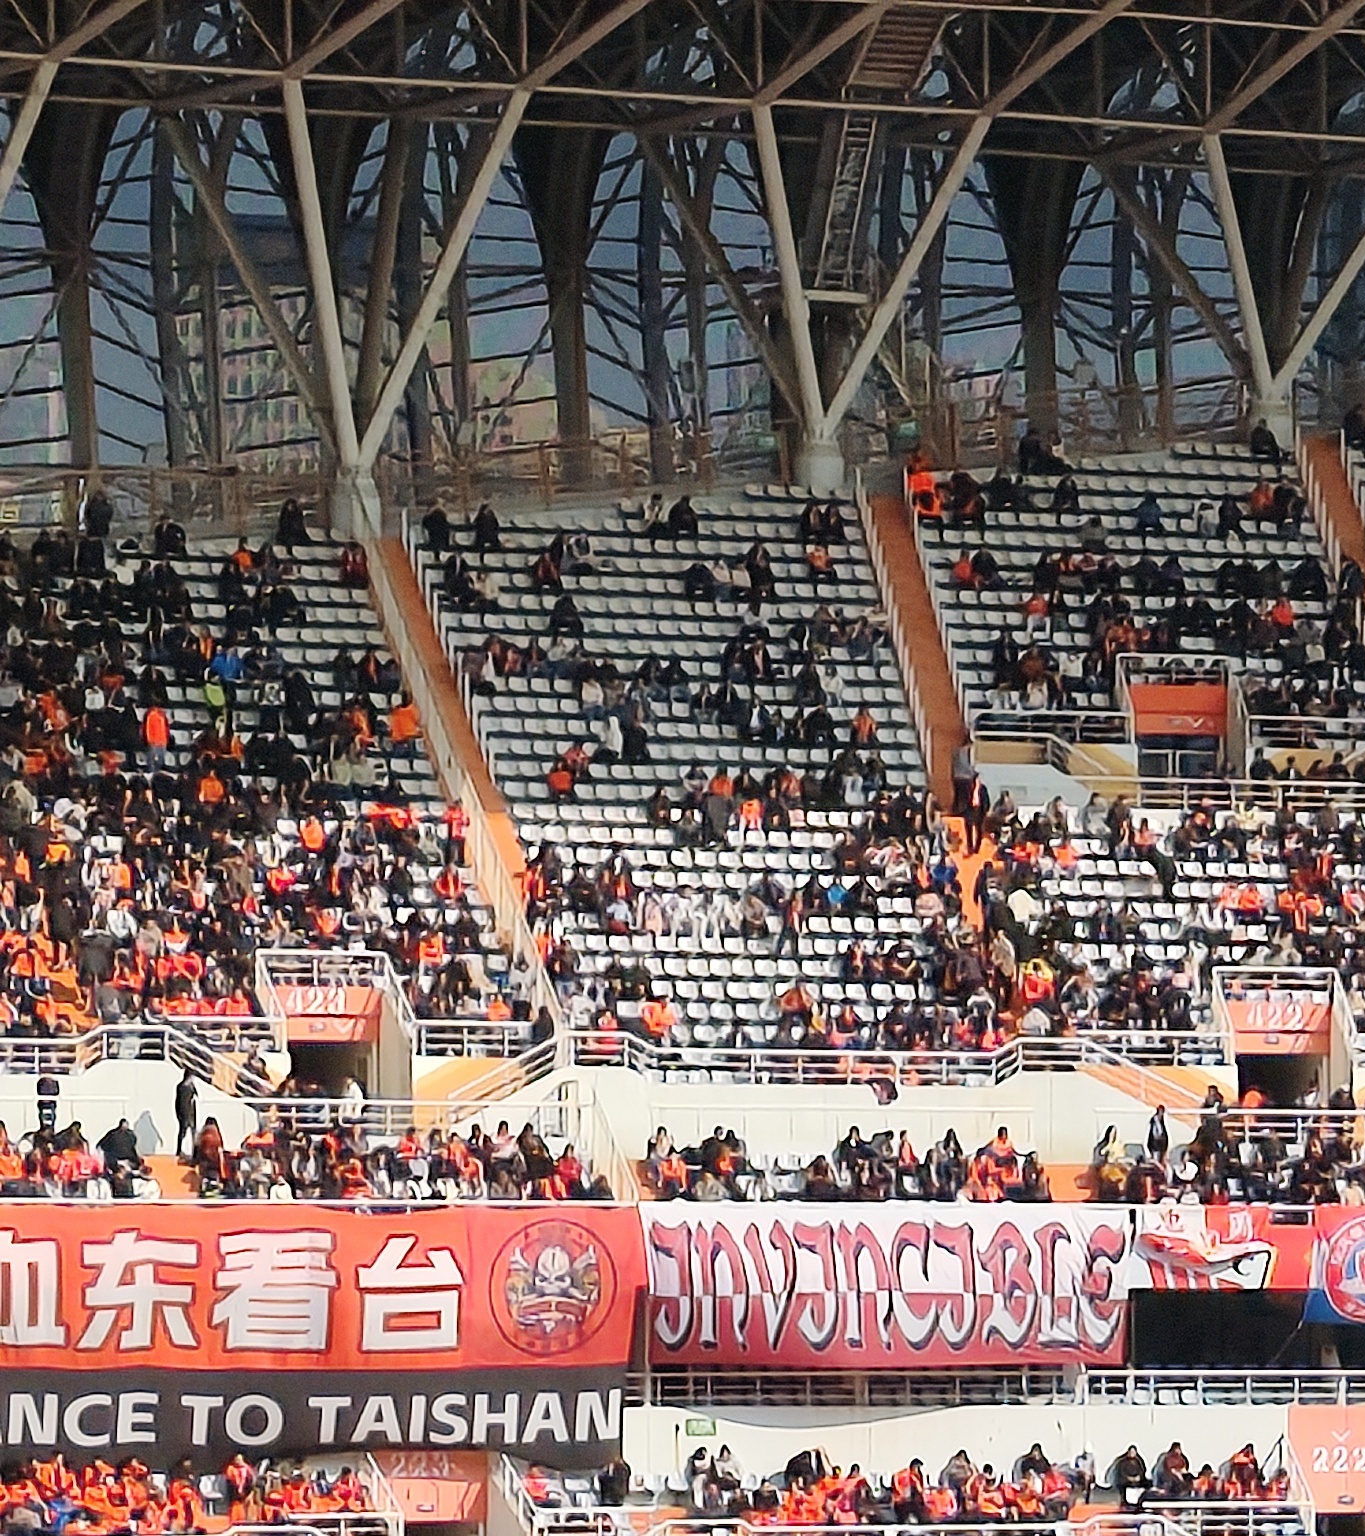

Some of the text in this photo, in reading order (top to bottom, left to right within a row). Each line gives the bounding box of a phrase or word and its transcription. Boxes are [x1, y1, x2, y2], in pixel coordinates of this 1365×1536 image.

[0, 1387, 622, 1447] NCE TO TAISHAN
